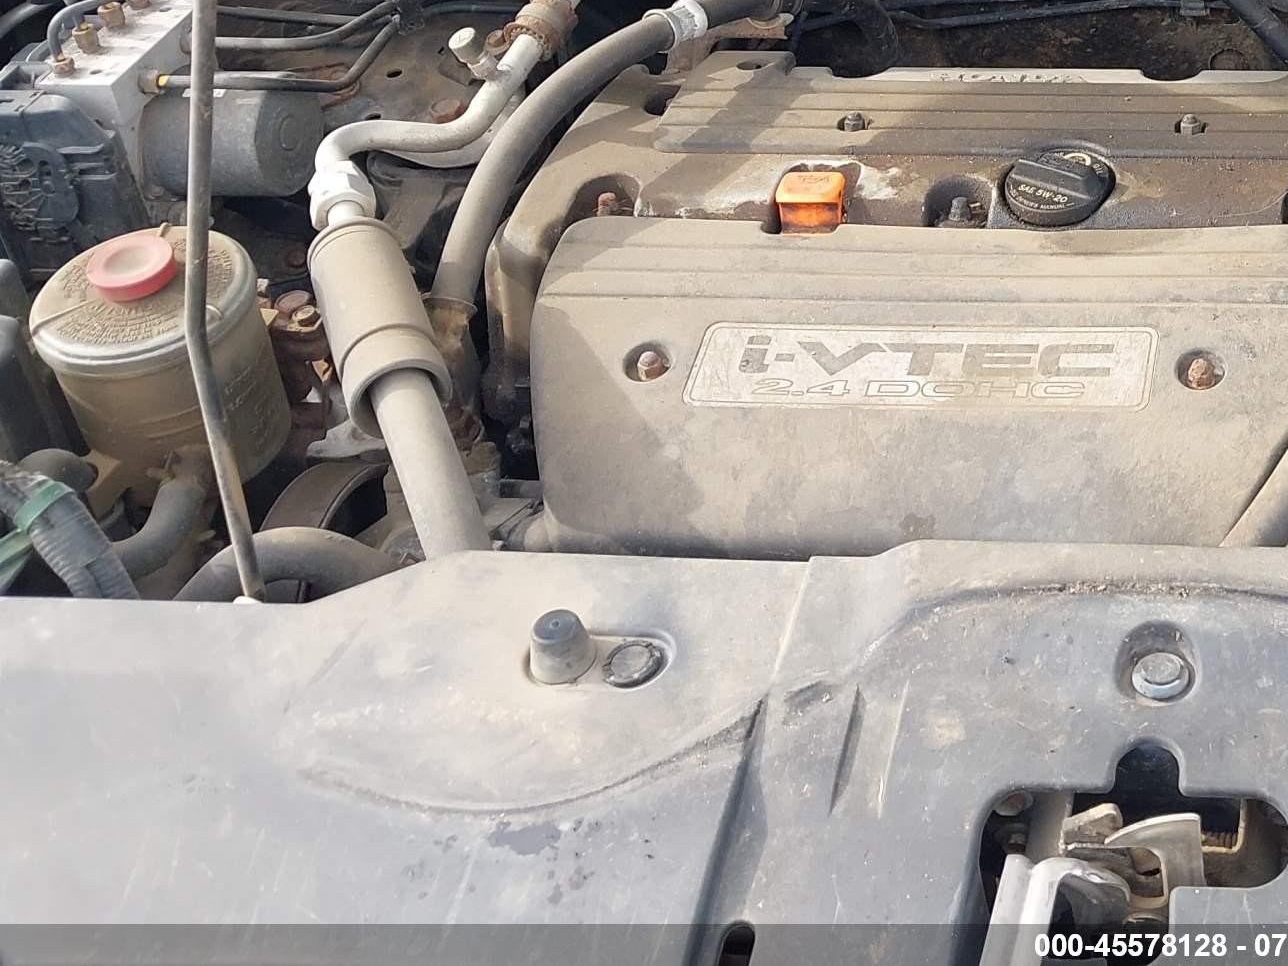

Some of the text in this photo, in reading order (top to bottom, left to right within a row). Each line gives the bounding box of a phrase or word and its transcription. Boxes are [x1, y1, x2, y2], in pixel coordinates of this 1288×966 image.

[1018, 183, 1069, 204] SAE 5W-20
[737, 334, 1115, 378] i-VTEC
[750, 378, 1088, 400] 2.4 DOHC
